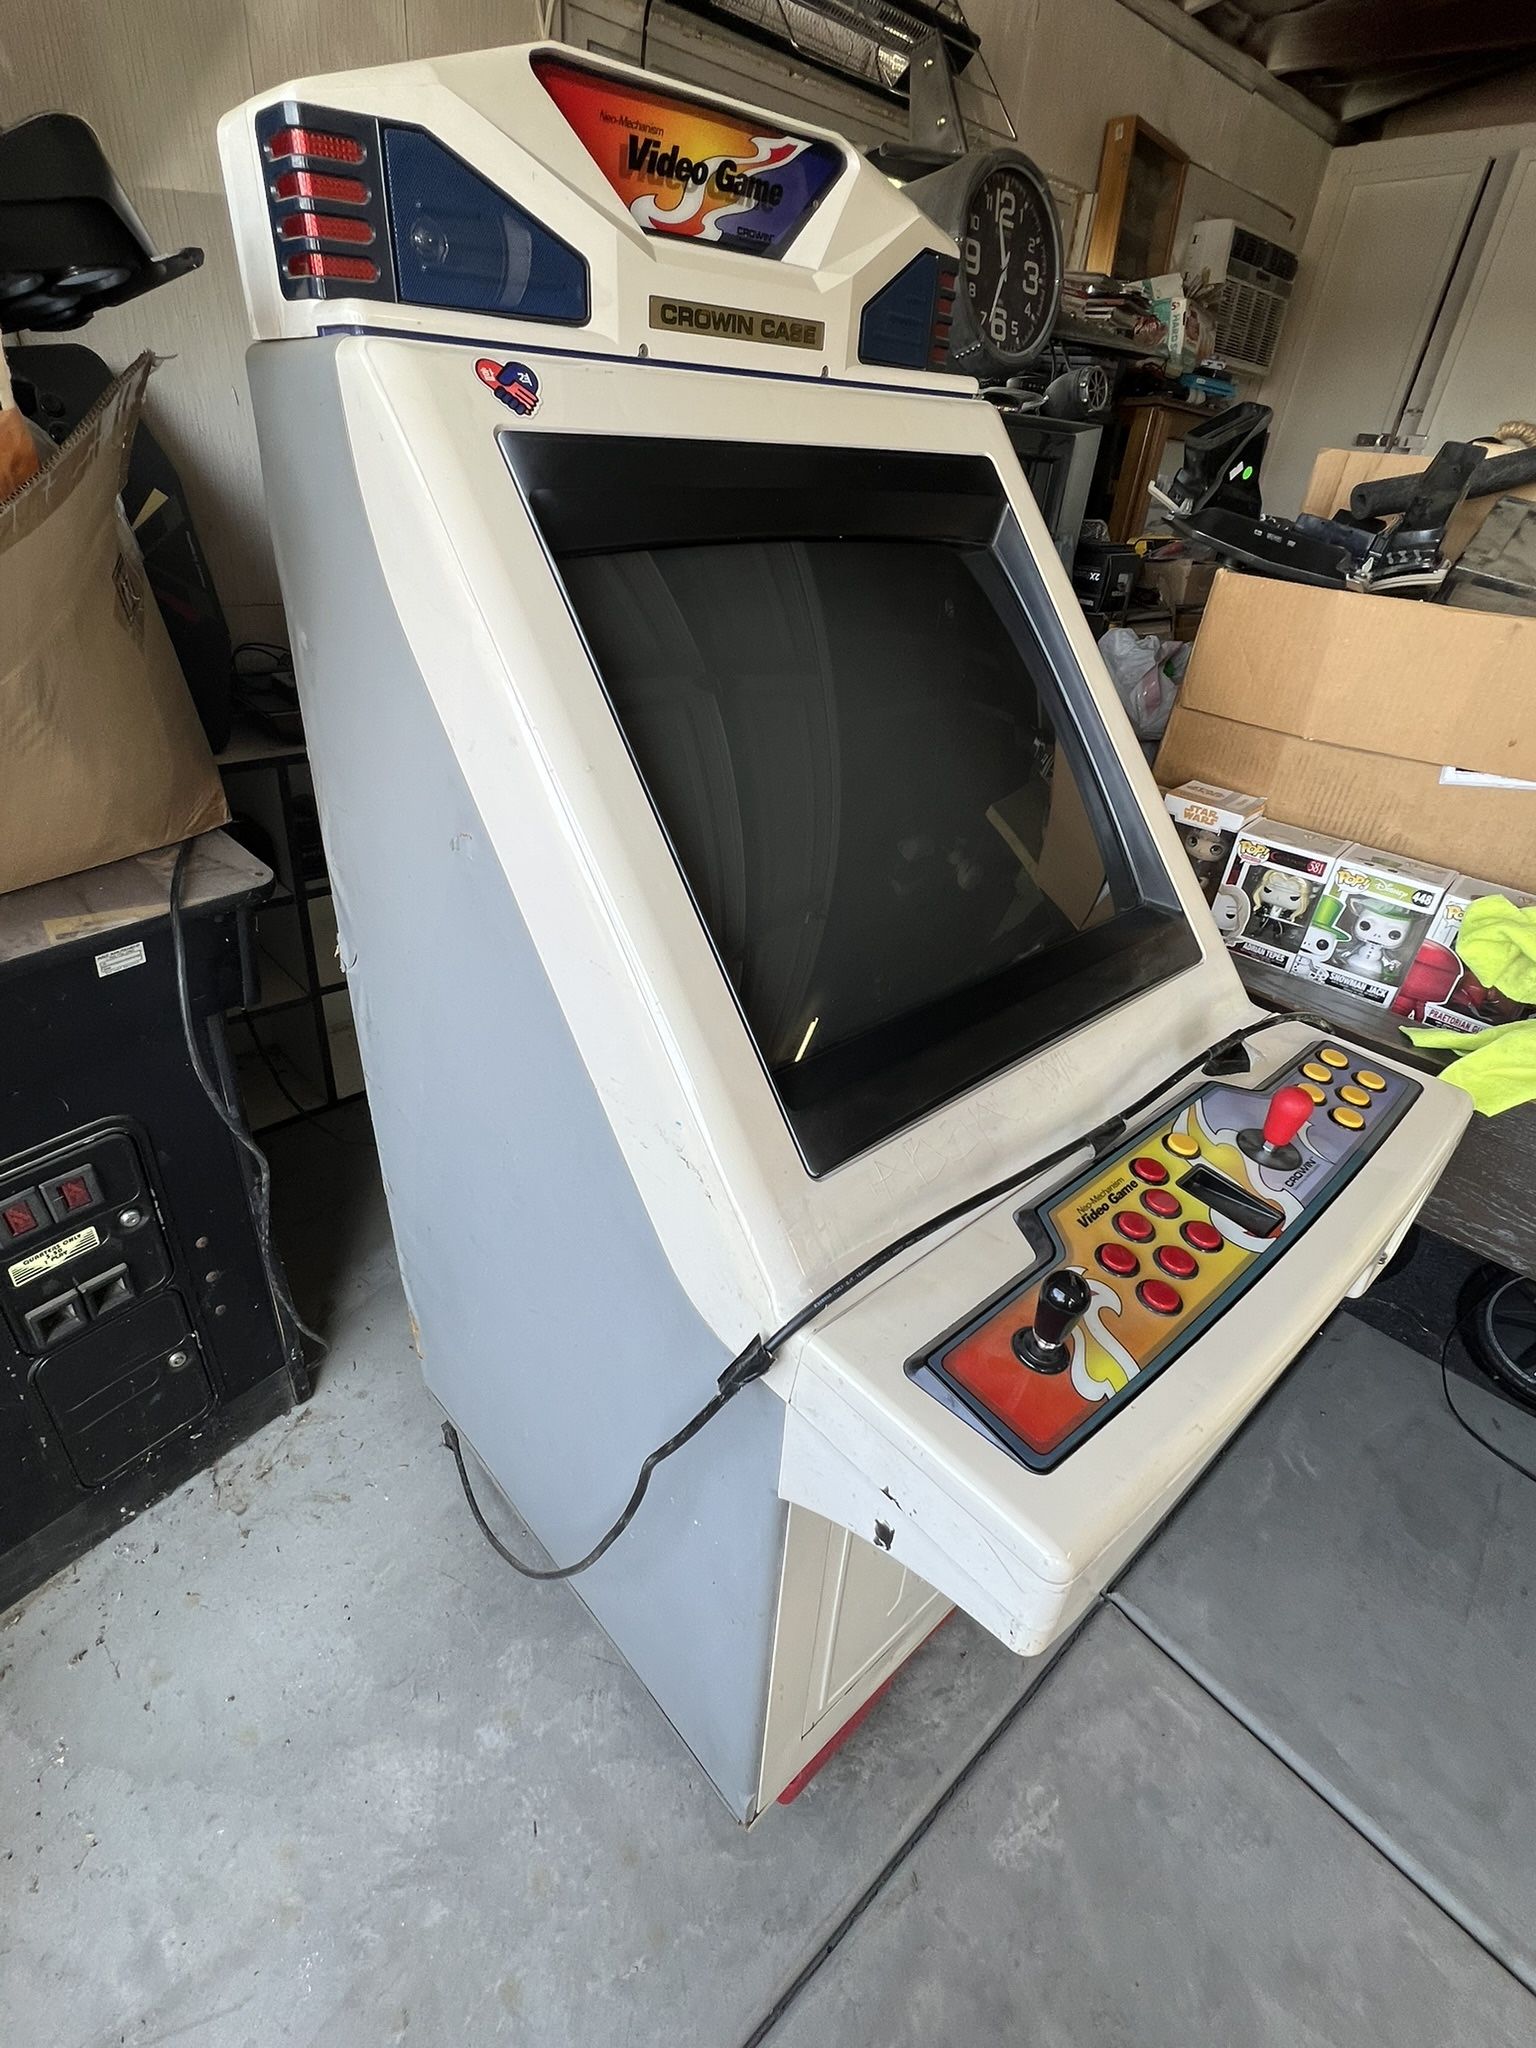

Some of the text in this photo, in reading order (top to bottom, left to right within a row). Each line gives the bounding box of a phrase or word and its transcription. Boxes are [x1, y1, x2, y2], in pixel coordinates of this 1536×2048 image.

[601, 112, 664, 135] Neo-Mechanism
[628, 135, 784, 205] Video Game
[986, 194, 993, 210] 11
[995, 188, 1016, 229] 12
[970, 214, 980, 231] 10
[1020, 208, 1025, 224] 1
[1028, 238, 1036, 253] 2
[965, 238, 981, 276] 9
[1023, 261, 1039, 295] 3
[969, 282, 976, 298] 8
[980, 311, 988, 325] 7
[1024, 303, 1031, 317] 4
[661, 304, 816, 344] CROWIN CASE
[990, 307, 1008, 342] 6
[1011, 321, 1018, 336] 5
[1184, 808, 1218, 826] WARS
[1189, 805, 1218, 819] STAR
[1239, 840, 1270, 859] POP!
[1307, 860, 1325, 875] 581
[1337, 869, 1432, 906] POP! Disney 448
[1446, 904, 1464, 921] PO
[1329, 971, 1366, 991] SNOWMAN
[1366, 985, 1389, 998] JACK
[1429, 1008, 1472, 1031] PRAETORIAN
[1285, 1159, 1317, 1188] CROWIN
[1077, 1177, 1125, 1214] Neo-Mechanism
[1077, 1180, 1138, 1229] Video Game
[23, 1234, 81, 1266] QUARTERS ONLY
[51, 1250, 68, 1262] PLAY
